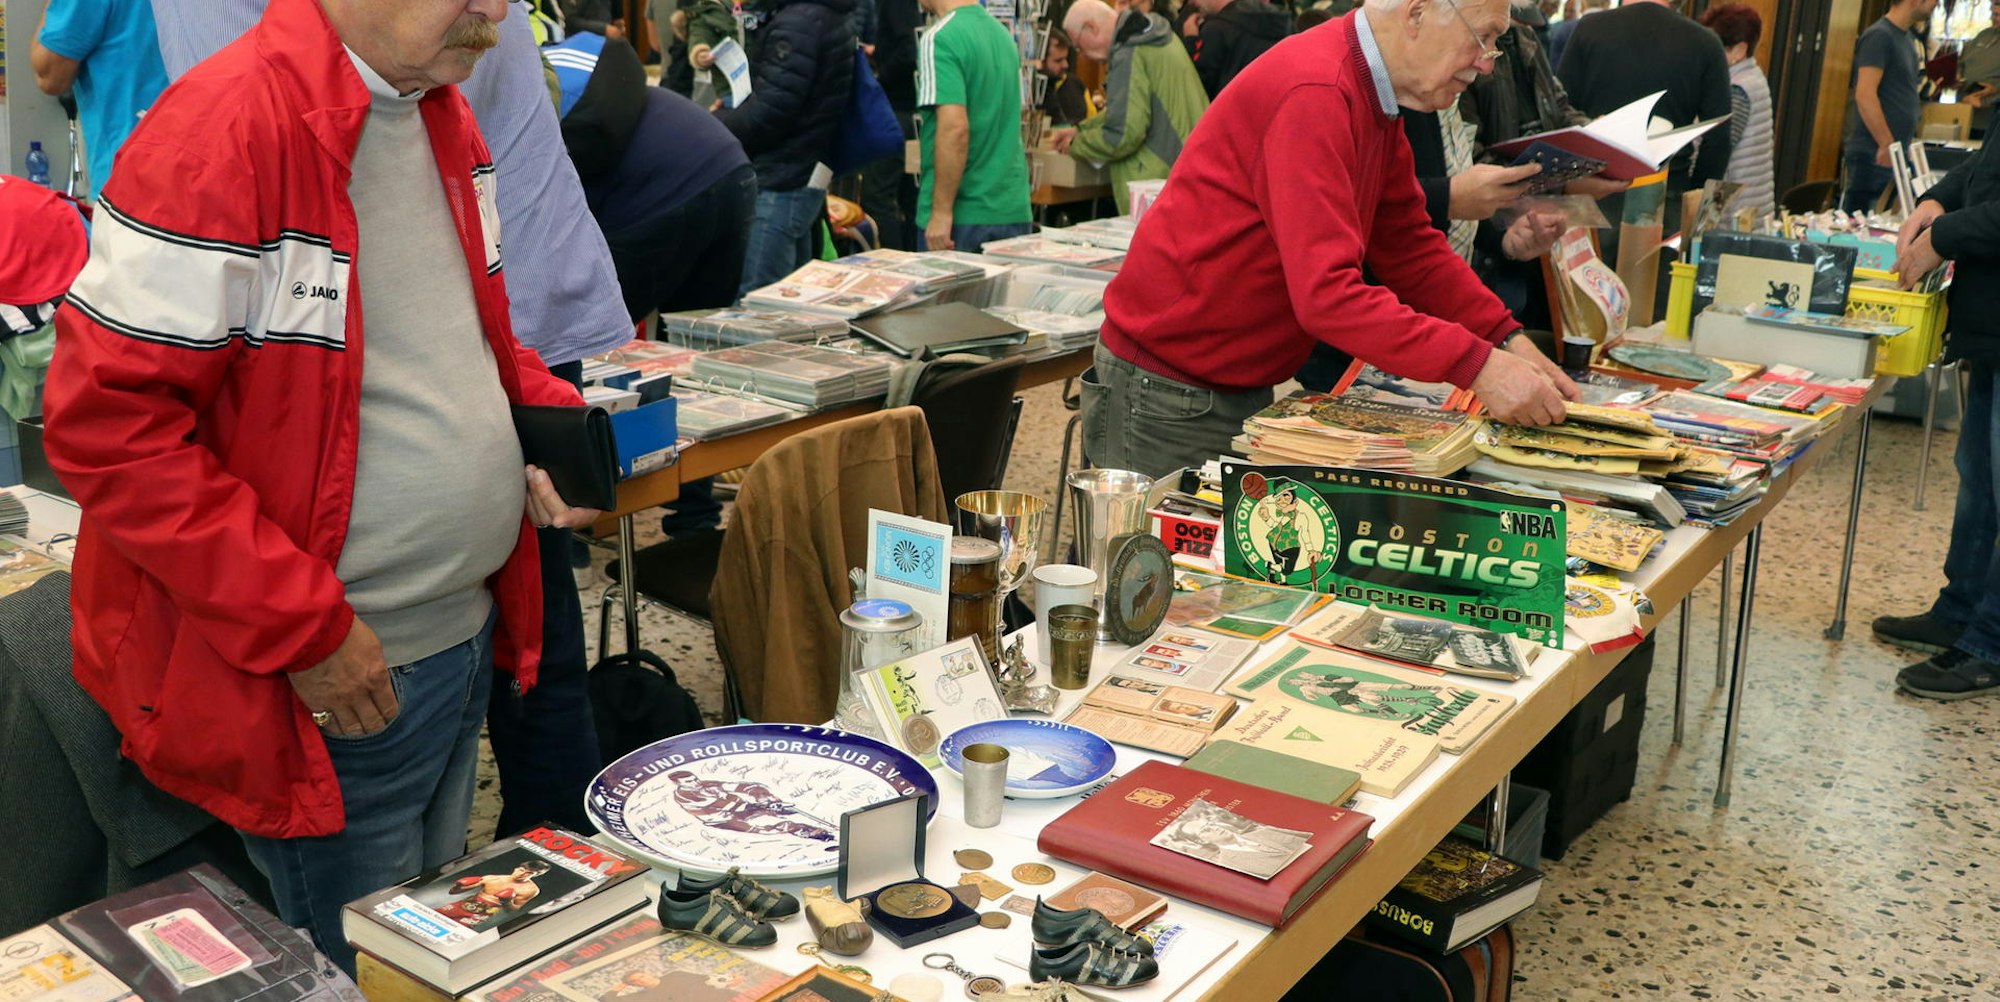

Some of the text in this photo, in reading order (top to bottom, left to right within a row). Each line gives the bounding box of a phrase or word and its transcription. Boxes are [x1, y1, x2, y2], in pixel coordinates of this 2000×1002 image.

[1315, 471, 1469, 496] PASS REQUIRED
[1237, 498, 1260, 565] BOSTON
[1309, 496, 1337, 563] CELTICS
[1511, 512, 1558, 540] NBA
[1347, 538, 1542, 589] CELTICS
[1328, 582, 1448, 613] LOCKER
[690, 739, 871, 766] ROLLSPORTCLUB
[520, 826, 638, 877] ROCKY
